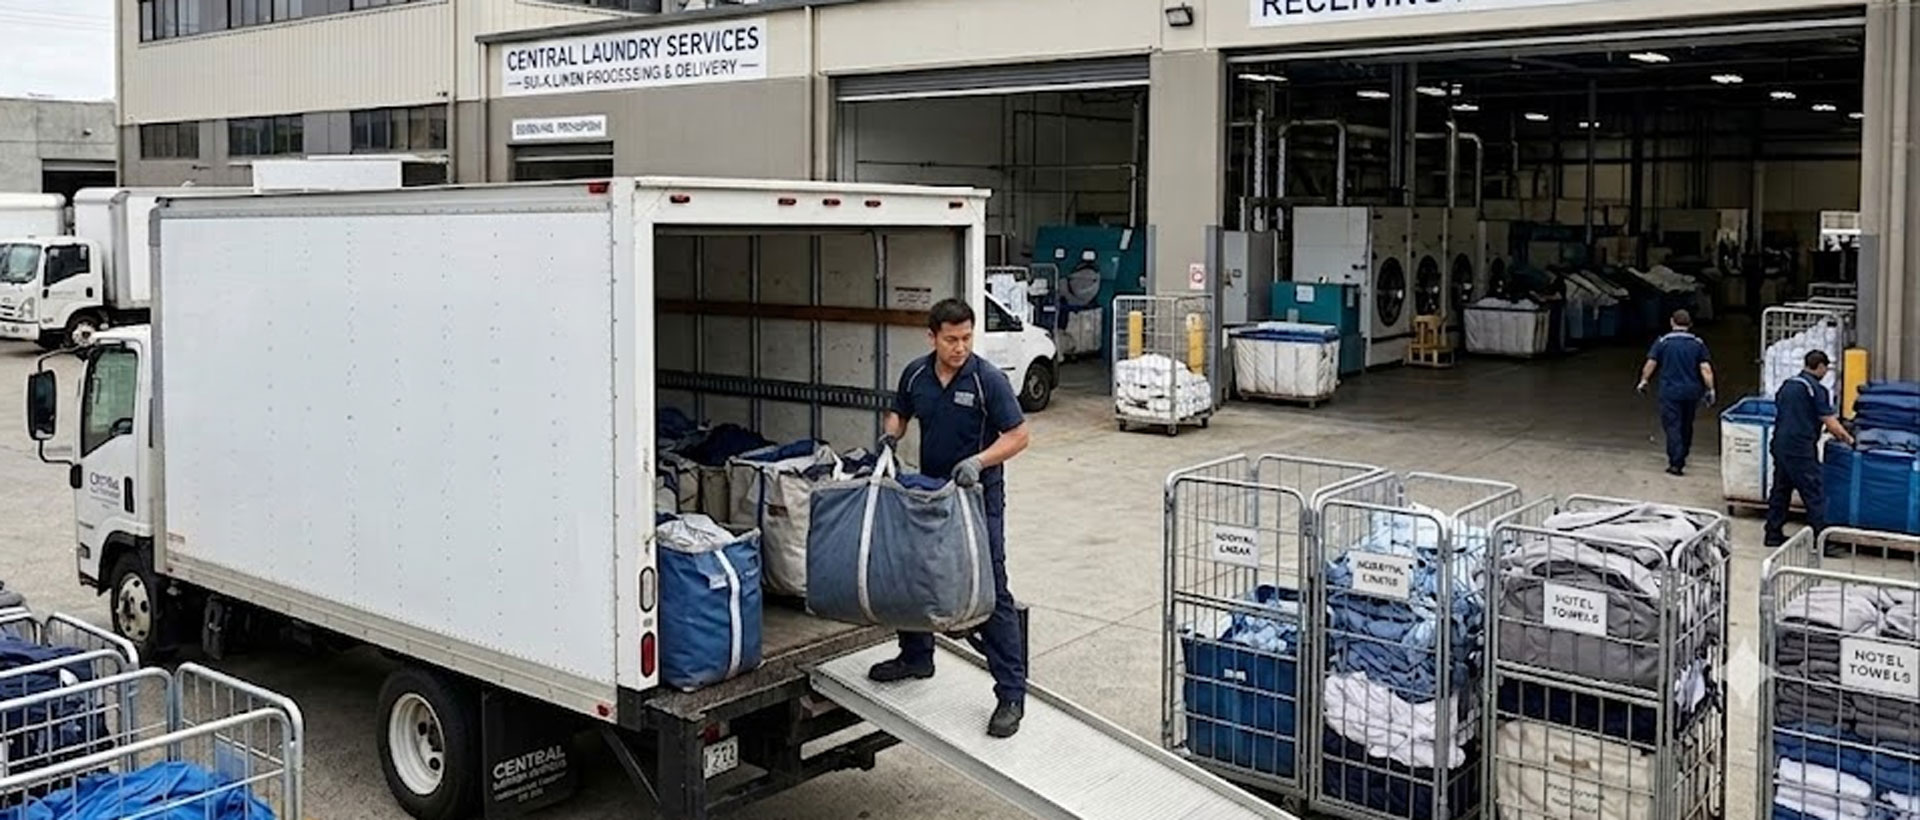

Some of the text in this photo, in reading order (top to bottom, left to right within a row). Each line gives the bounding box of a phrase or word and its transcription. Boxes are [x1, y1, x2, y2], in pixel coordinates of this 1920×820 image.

[508, 26, 759, 71] CENTRAL LAUNDRY SERVICES
